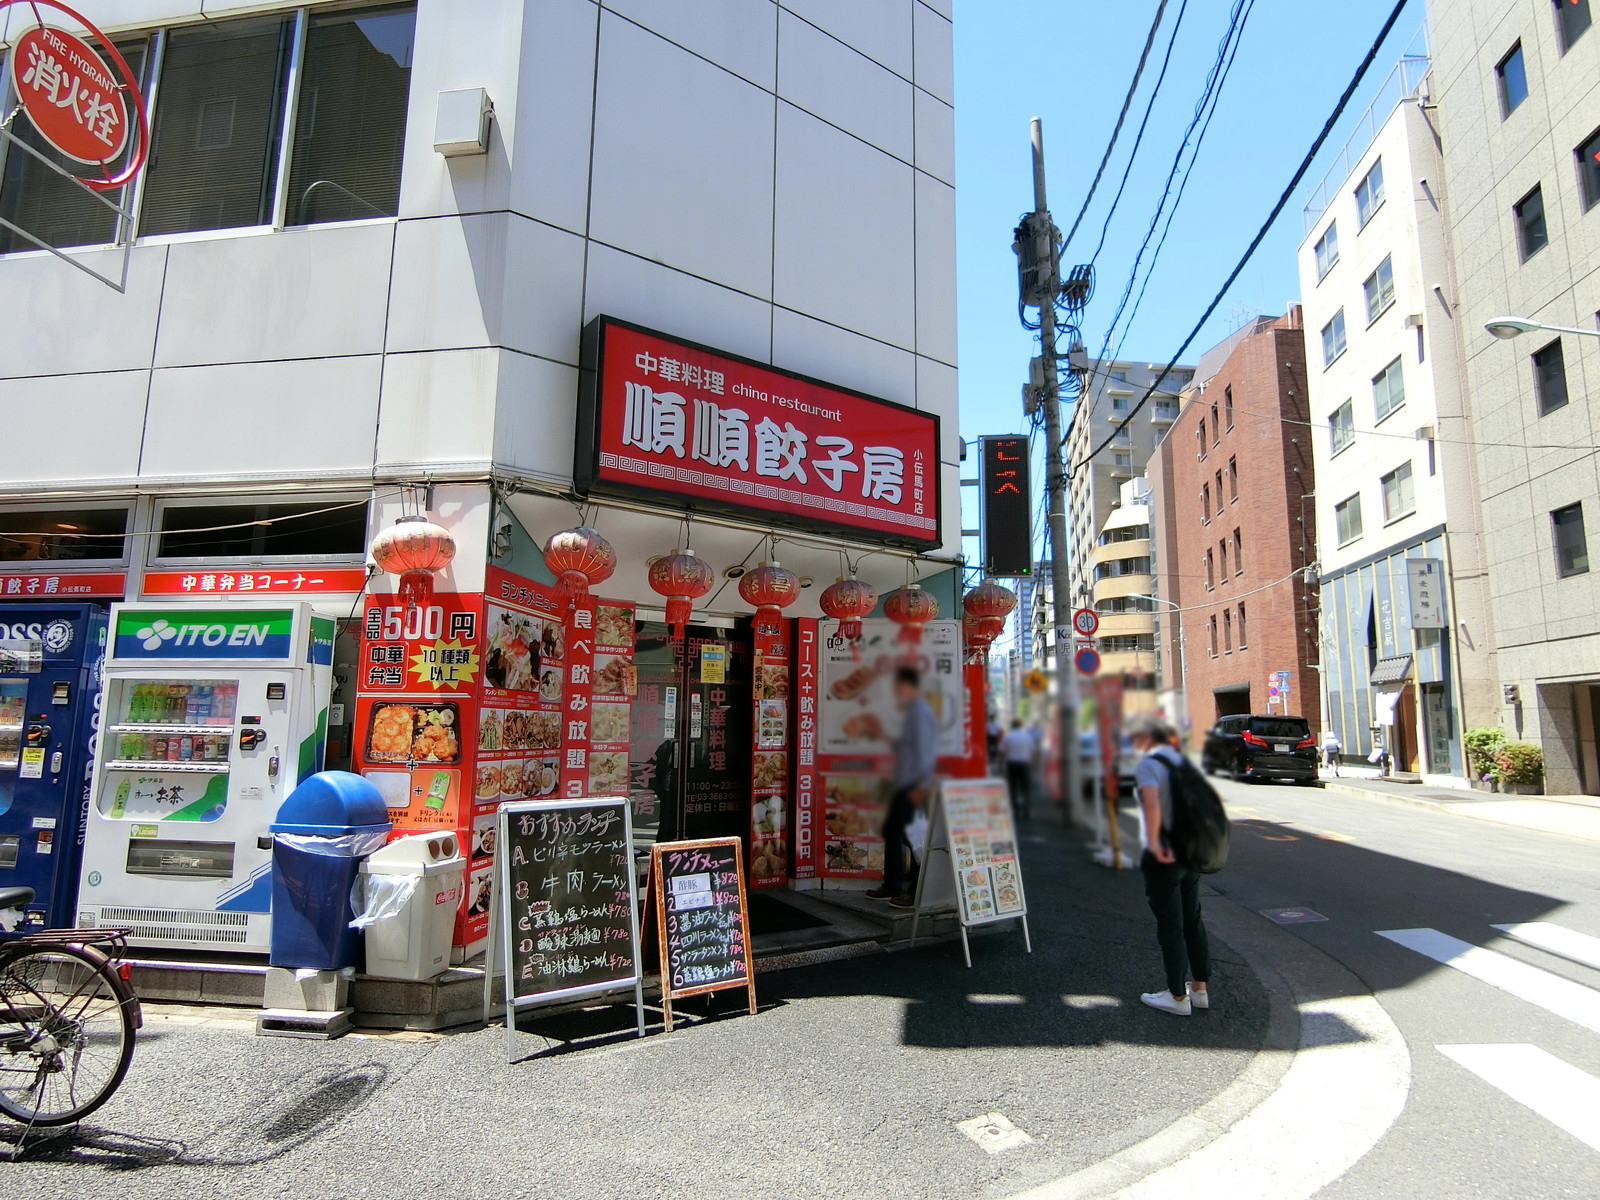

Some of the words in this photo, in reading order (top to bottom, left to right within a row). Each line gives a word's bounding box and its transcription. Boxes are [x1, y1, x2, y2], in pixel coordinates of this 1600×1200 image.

[42, 29, 67, 56] FIRE
[69, 50, 117, 95] HYDRANT
[23, 41, 119, 147] 消火栓
[635, 351, 725, 396] 中華料理
[732, 382, 768, 403] china
[772, 393, 842, 422] restaurant
[622, 380, 905, 505] 順順餃子房
[912, 448, 924, 515] 小伝馬町店
[182, 573, 325, 591] 中華弁当コーナー
[501, 580, 558, 611] ランチメニュー
[366, 608, 382, 639] 全品
[1079, 616, 1094, 629] 30
[175, 624, 227, 646] ITO
[227, 624, 270, 646] EN
[371, 645, 404, 663] 中華
[423, 649, 470, 664] 10種類
[369, 667, 402, 684] 弁当
[430, 666, 459, 681] 以上
[709, 687, 727, 771] 中華料理
[77, 785, 91, 846] SUNTORY
[517, 809, 621, 844] おすすめランチ
[534, 840, 627, 862] ピリ辛モツラーメン
[665, 878, 673, 895] 1
[678, 879, 698, 891] 酢豚
[667, 897, 677, 913] 2
[681, 896, 707, 905] エビチリ
[668, 915, 678, 933] 3
[669, 934, 681, 951] 4
[681, 929, 721, 948] 四川ラーメン
[671, 949, 682, 967] 5
[680, 945, 723, 963] サンラータンメン
[673, 966, 684, 986] 6
